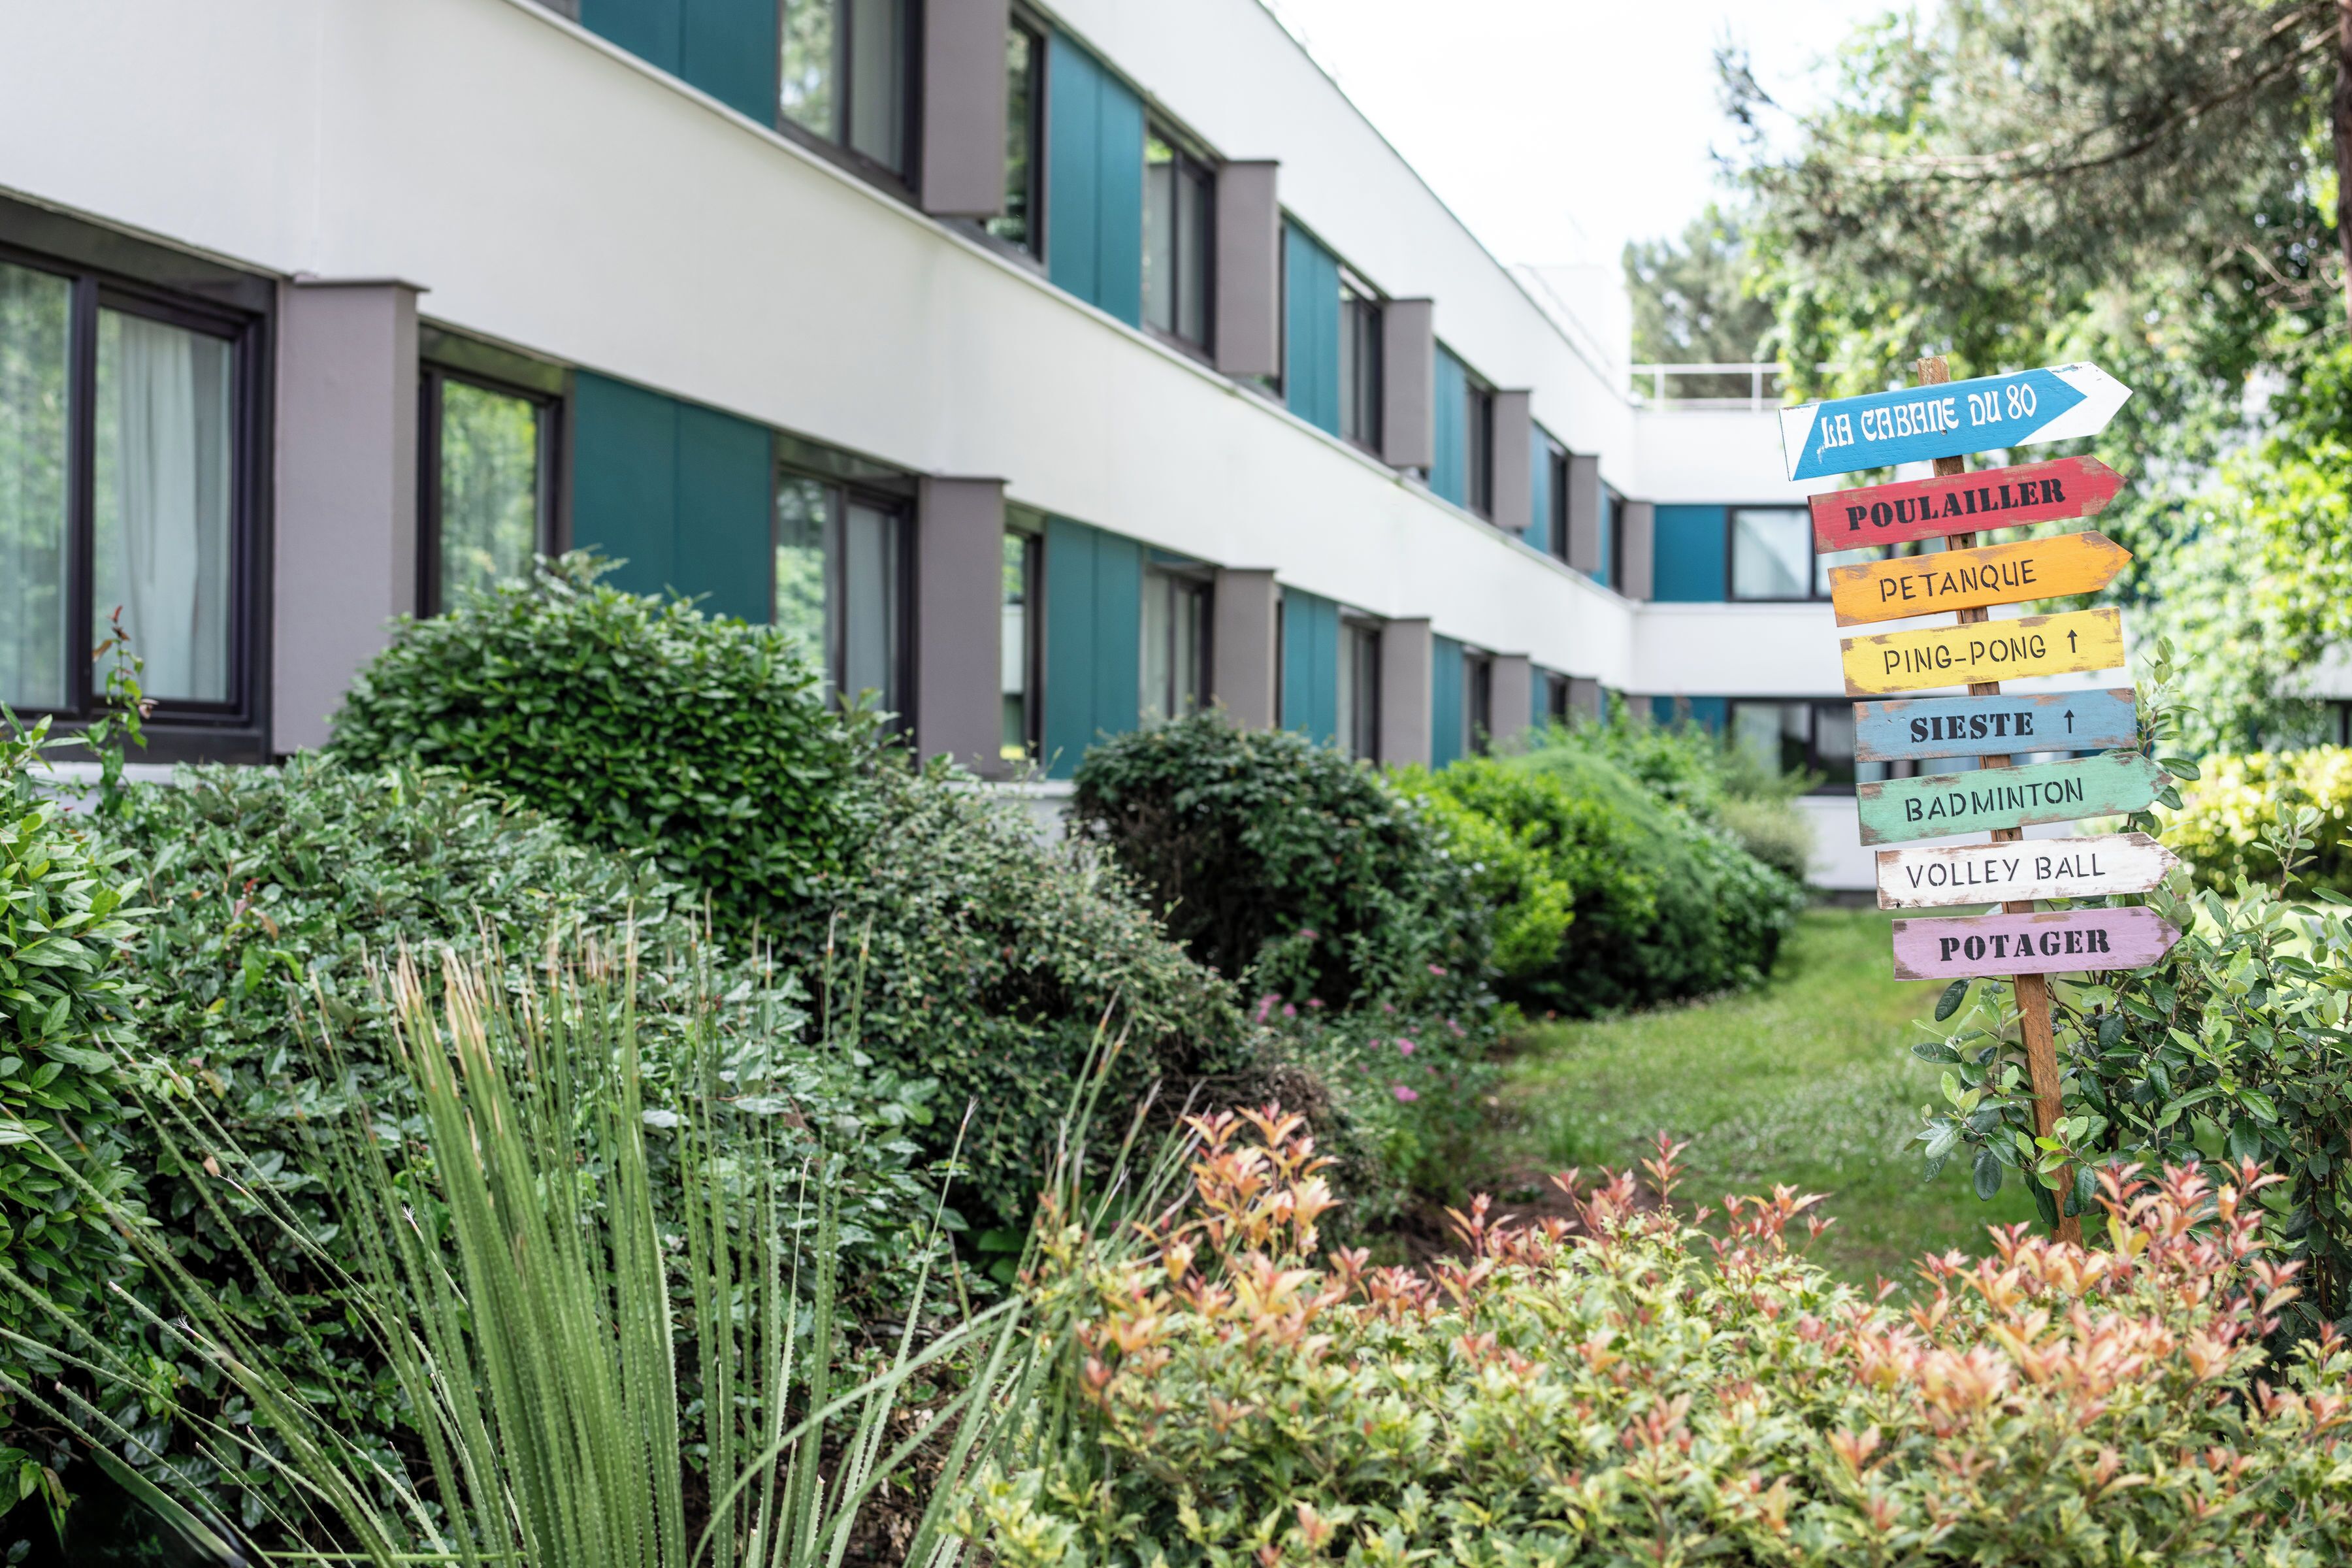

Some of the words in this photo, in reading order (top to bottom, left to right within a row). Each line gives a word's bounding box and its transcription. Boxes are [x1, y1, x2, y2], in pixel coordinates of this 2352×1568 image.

[1820, 416, 1855, 448] LA
[1861, 397, 1960, 443] CABANE
[1967, 390, 2002, 427] DU
[2006, 382, 2037, 421] 80
[1846, 478, 2066, 531] POULAILLER
[1879, 559, 2037, 602] PETANQUE
[1884, 634, 2046, 675] PING-PONG
[1910, 712, 2034, 743] SIESTE
[1905, 777, 2083, 822] BADMINTON
[1906, 858, 2020, 889] VOLLEY
[2035, 853, 2106, 880] BALL
[1938, 928, 2111, 962] POTAGER
